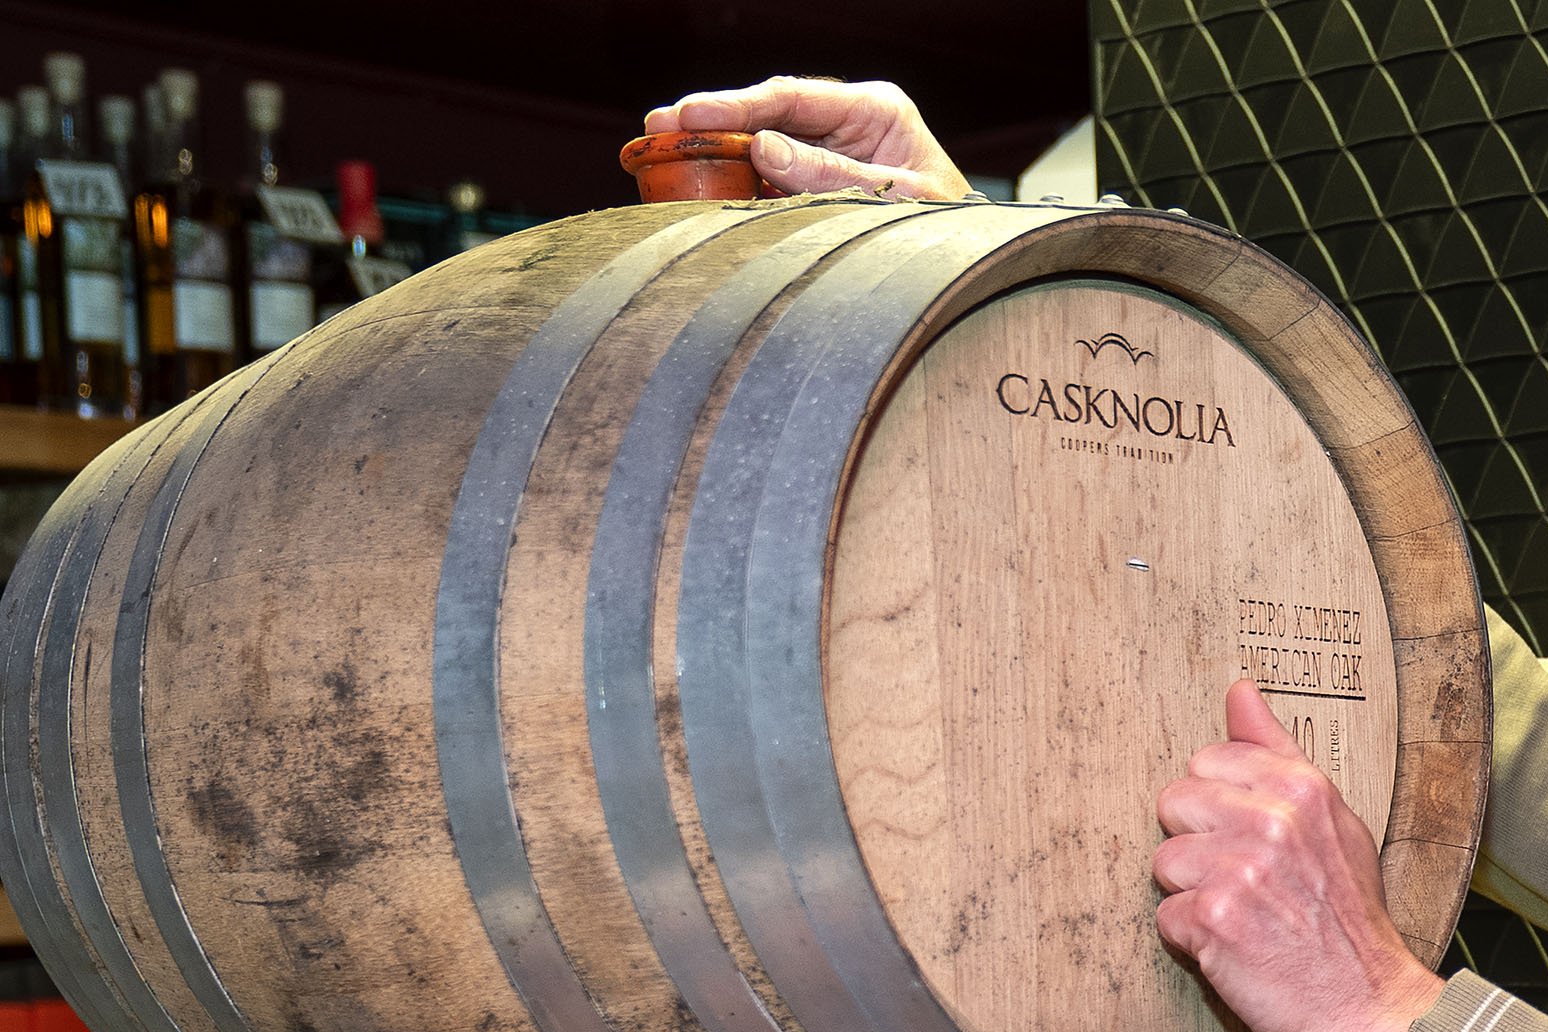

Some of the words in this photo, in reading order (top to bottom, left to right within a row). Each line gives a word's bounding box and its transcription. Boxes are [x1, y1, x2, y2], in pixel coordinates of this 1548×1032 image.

[995, 373, 1236, 448] CASKNOLIA
[1060, 437, 1110, 456] COOPERS
[1116, 445, 1174, 465] TRADITION
[1239, 599, 1287, 638] PEDRO
[1293, 605, 1362, 645] XIMENEZ
[1240, 644, 1322, 688] AMERICAN
[1331, 653, 1363, 692] OAK
[1330, 719, 1340, 772] LITRES
